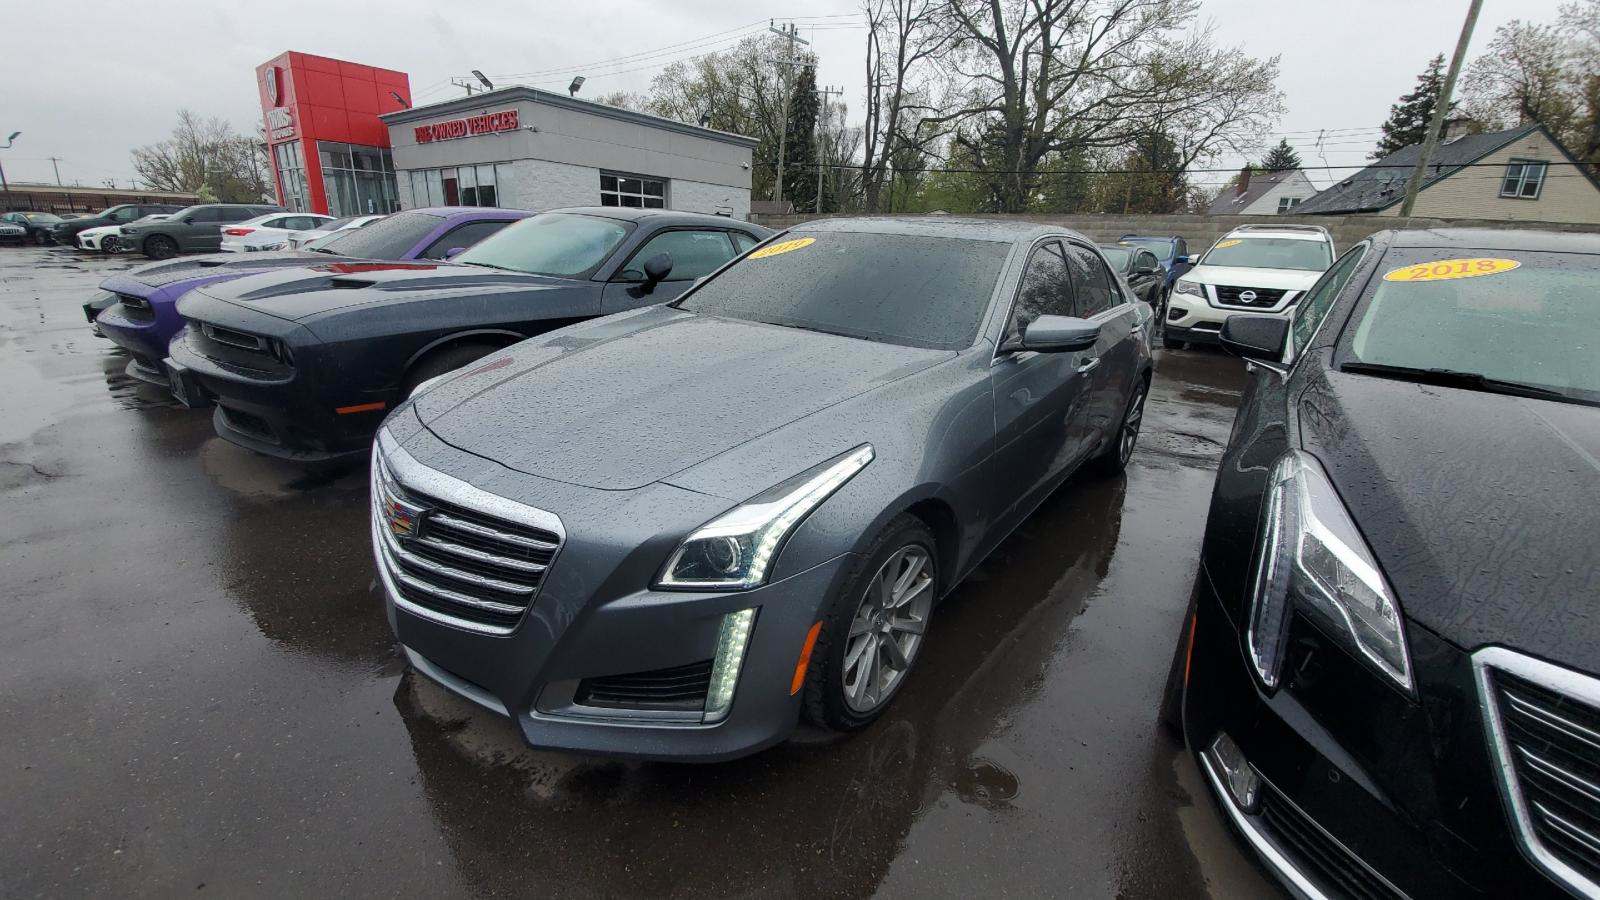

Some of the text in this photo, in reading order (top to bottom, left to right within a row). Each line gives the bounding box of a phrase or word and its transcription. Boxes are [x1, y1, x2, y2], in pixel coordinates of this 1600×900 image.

[432, 119, 467, 140] OWNED
[467, 110, 518, 135] VEHICLES
[1410, 260, 1497, 280] 2018
